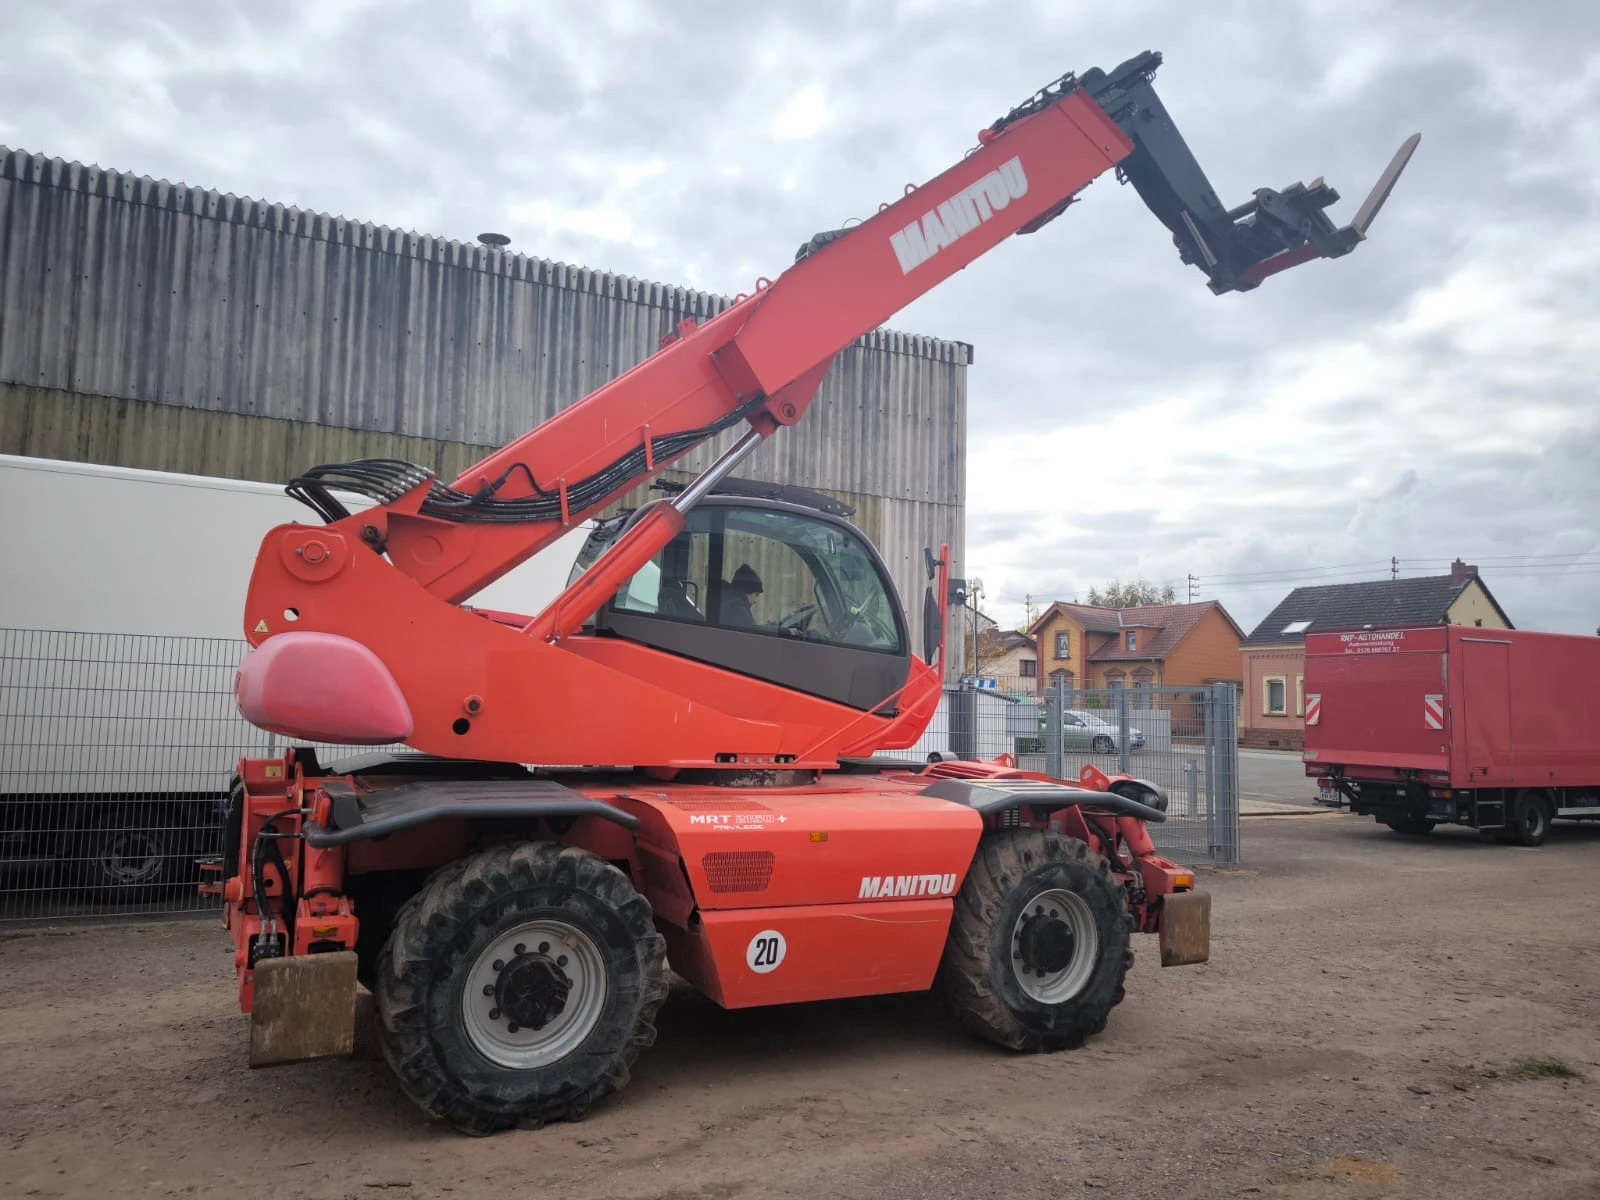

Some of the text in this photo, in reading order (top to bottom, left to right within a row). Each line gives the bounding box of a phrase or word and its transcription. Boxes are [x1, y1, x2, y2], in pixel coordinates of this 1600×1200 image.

[889, 155, 1028, 276] MANITOU
[690, 815, 731, 824] MRT
[735, 814, 775, 824] 2150
[858, 873, 956, 898] MANITOU
[754, 937, 779, 966] 20
